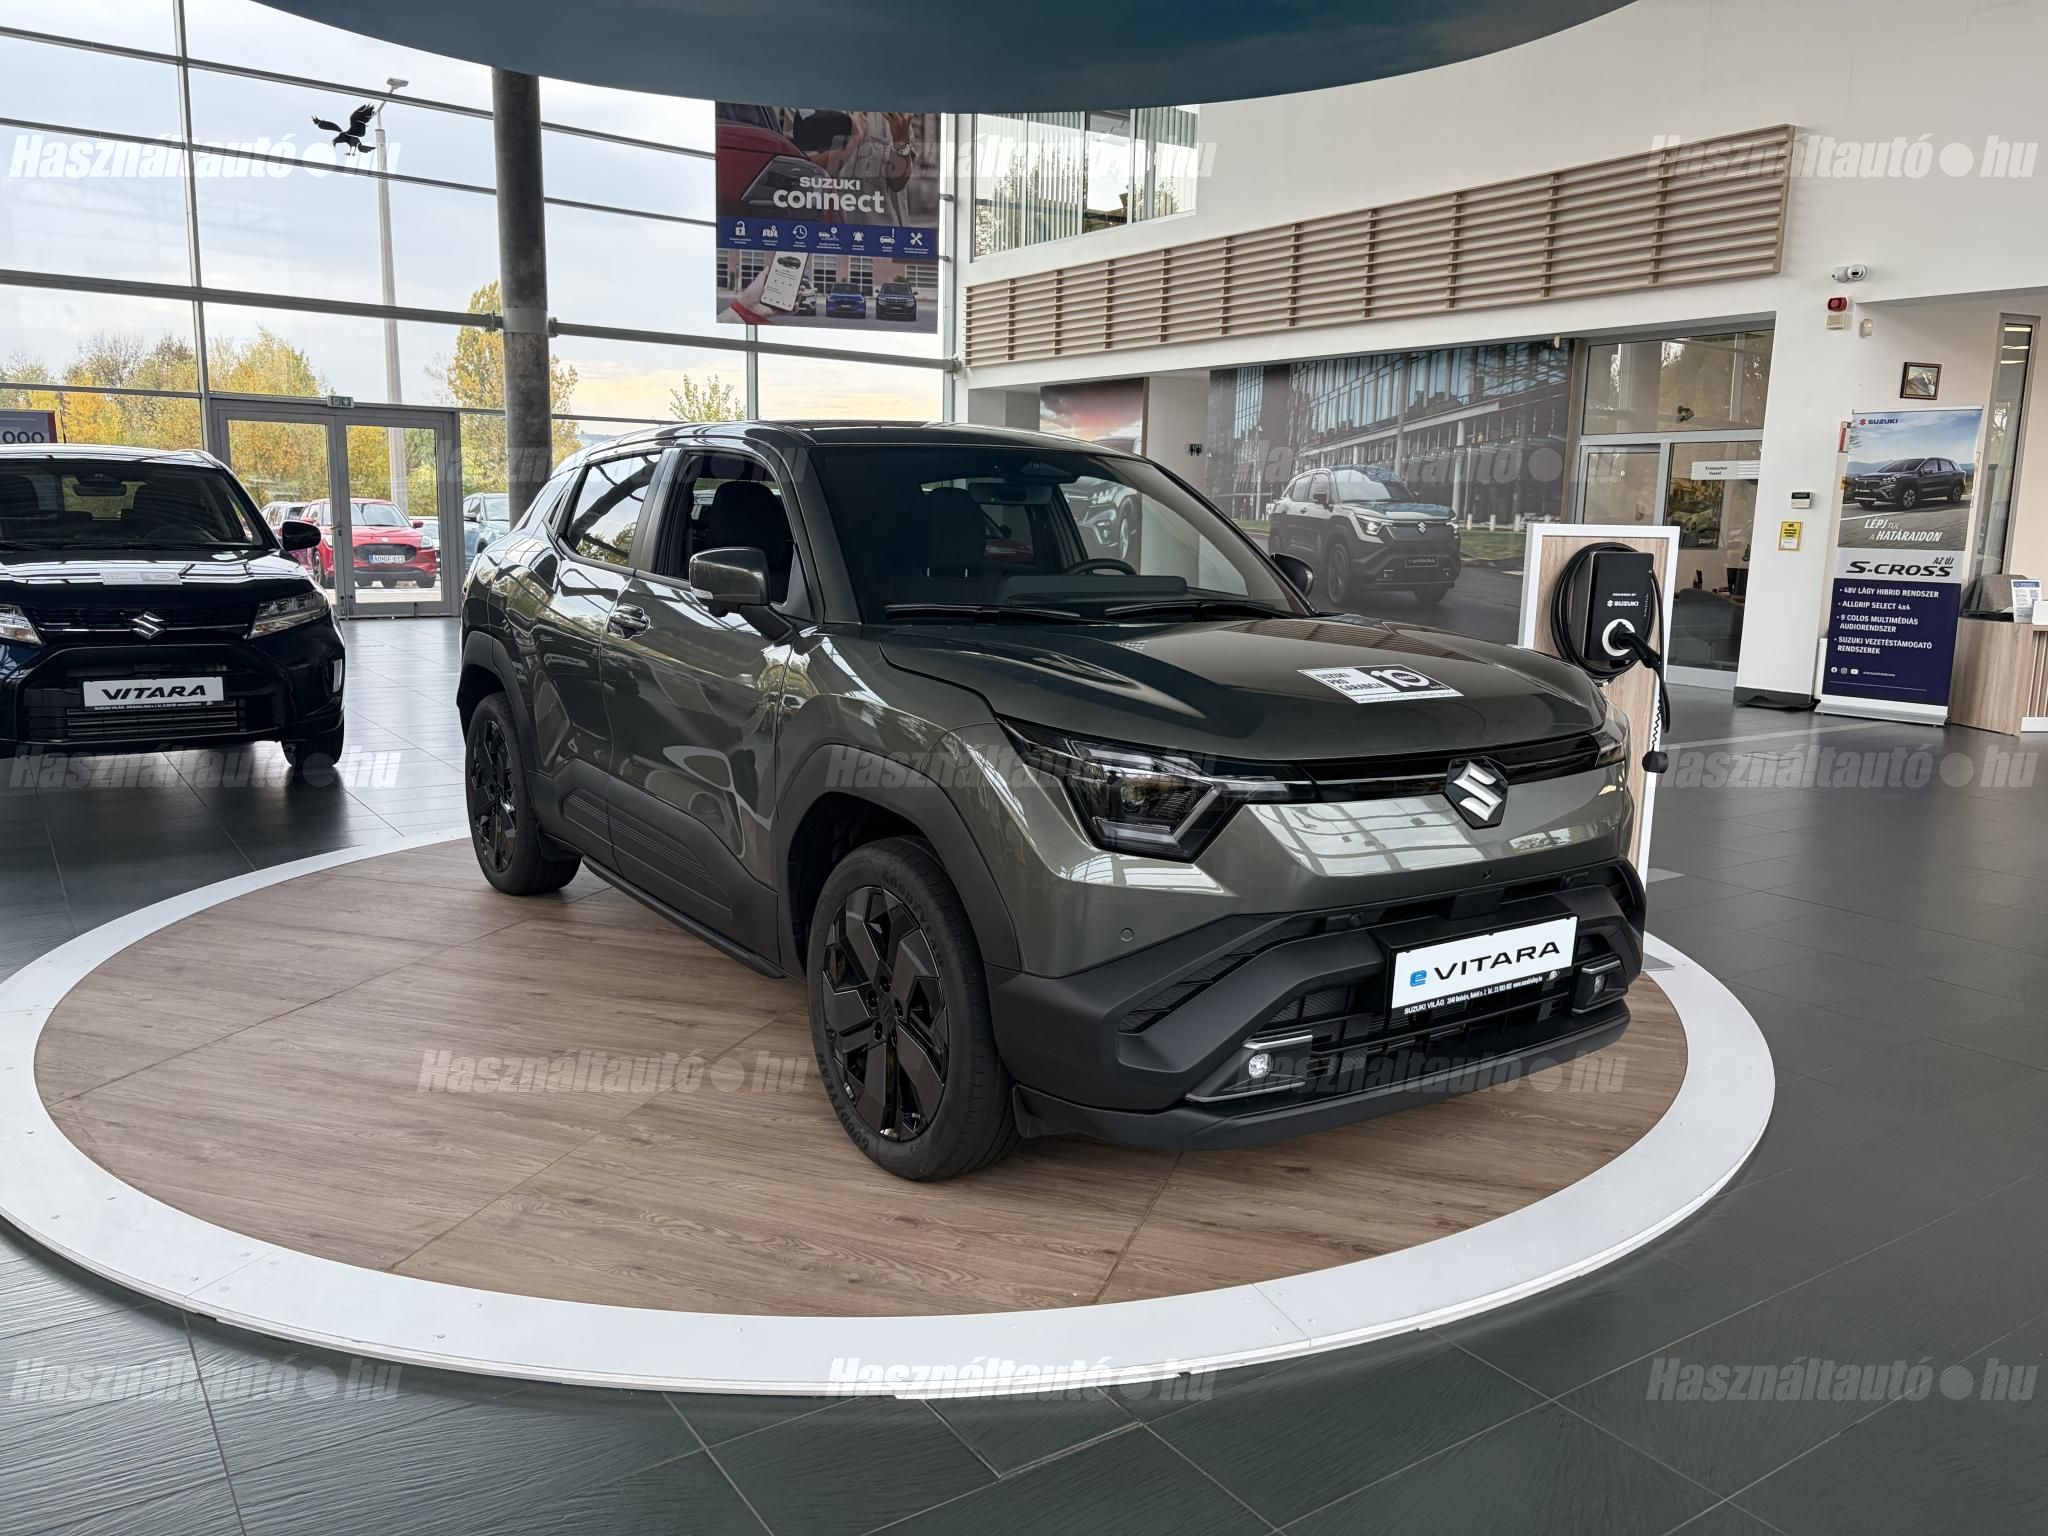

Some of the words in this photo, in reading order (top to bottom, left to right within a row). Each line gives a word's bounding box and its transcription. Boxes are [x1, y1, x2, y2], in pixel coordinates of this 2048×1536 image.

[799, 176, 861, 191] SUZUKI
[773, 189, 884, 214] connect
[1864, 516, 1889, 529] LÉPJ
[1876, 528, 1943, 542] HATÁRAIDON
[1846, 561, 1954, 577] S-CROSS
[1858, 586, 1875, 595] LÁGY
[1877, 588, 1900, 596] HIBRID
[1902, 590, 1939, 598] RENDSZER
[1842, 600, 1870, 608] ALLGRIP
[1871, 602, 1896, 610] SELECT
[1847, 614, 1869, 622] COLOS
[1870, 615, 1918, 625] MULTIMÉDIÁS
[1840, 623, 1896, 633] AUDIORENDSZER
[1838, 636, 1863, 644] SUZUKI
[1865, 637, 1932, 649] VEZETÉSTÁMOGATÓ
[1837, 645, 1880, 654] RENDSZEREK
[101, 685, 206, 700] VITARA
[1409, 969, 1427, 987] e
[1434, 941, 1560, 980] VITARA
[1404, 1003, 1426, 1015] SUZUKI
[1427, 999, 1444, 1010] VILÁG
